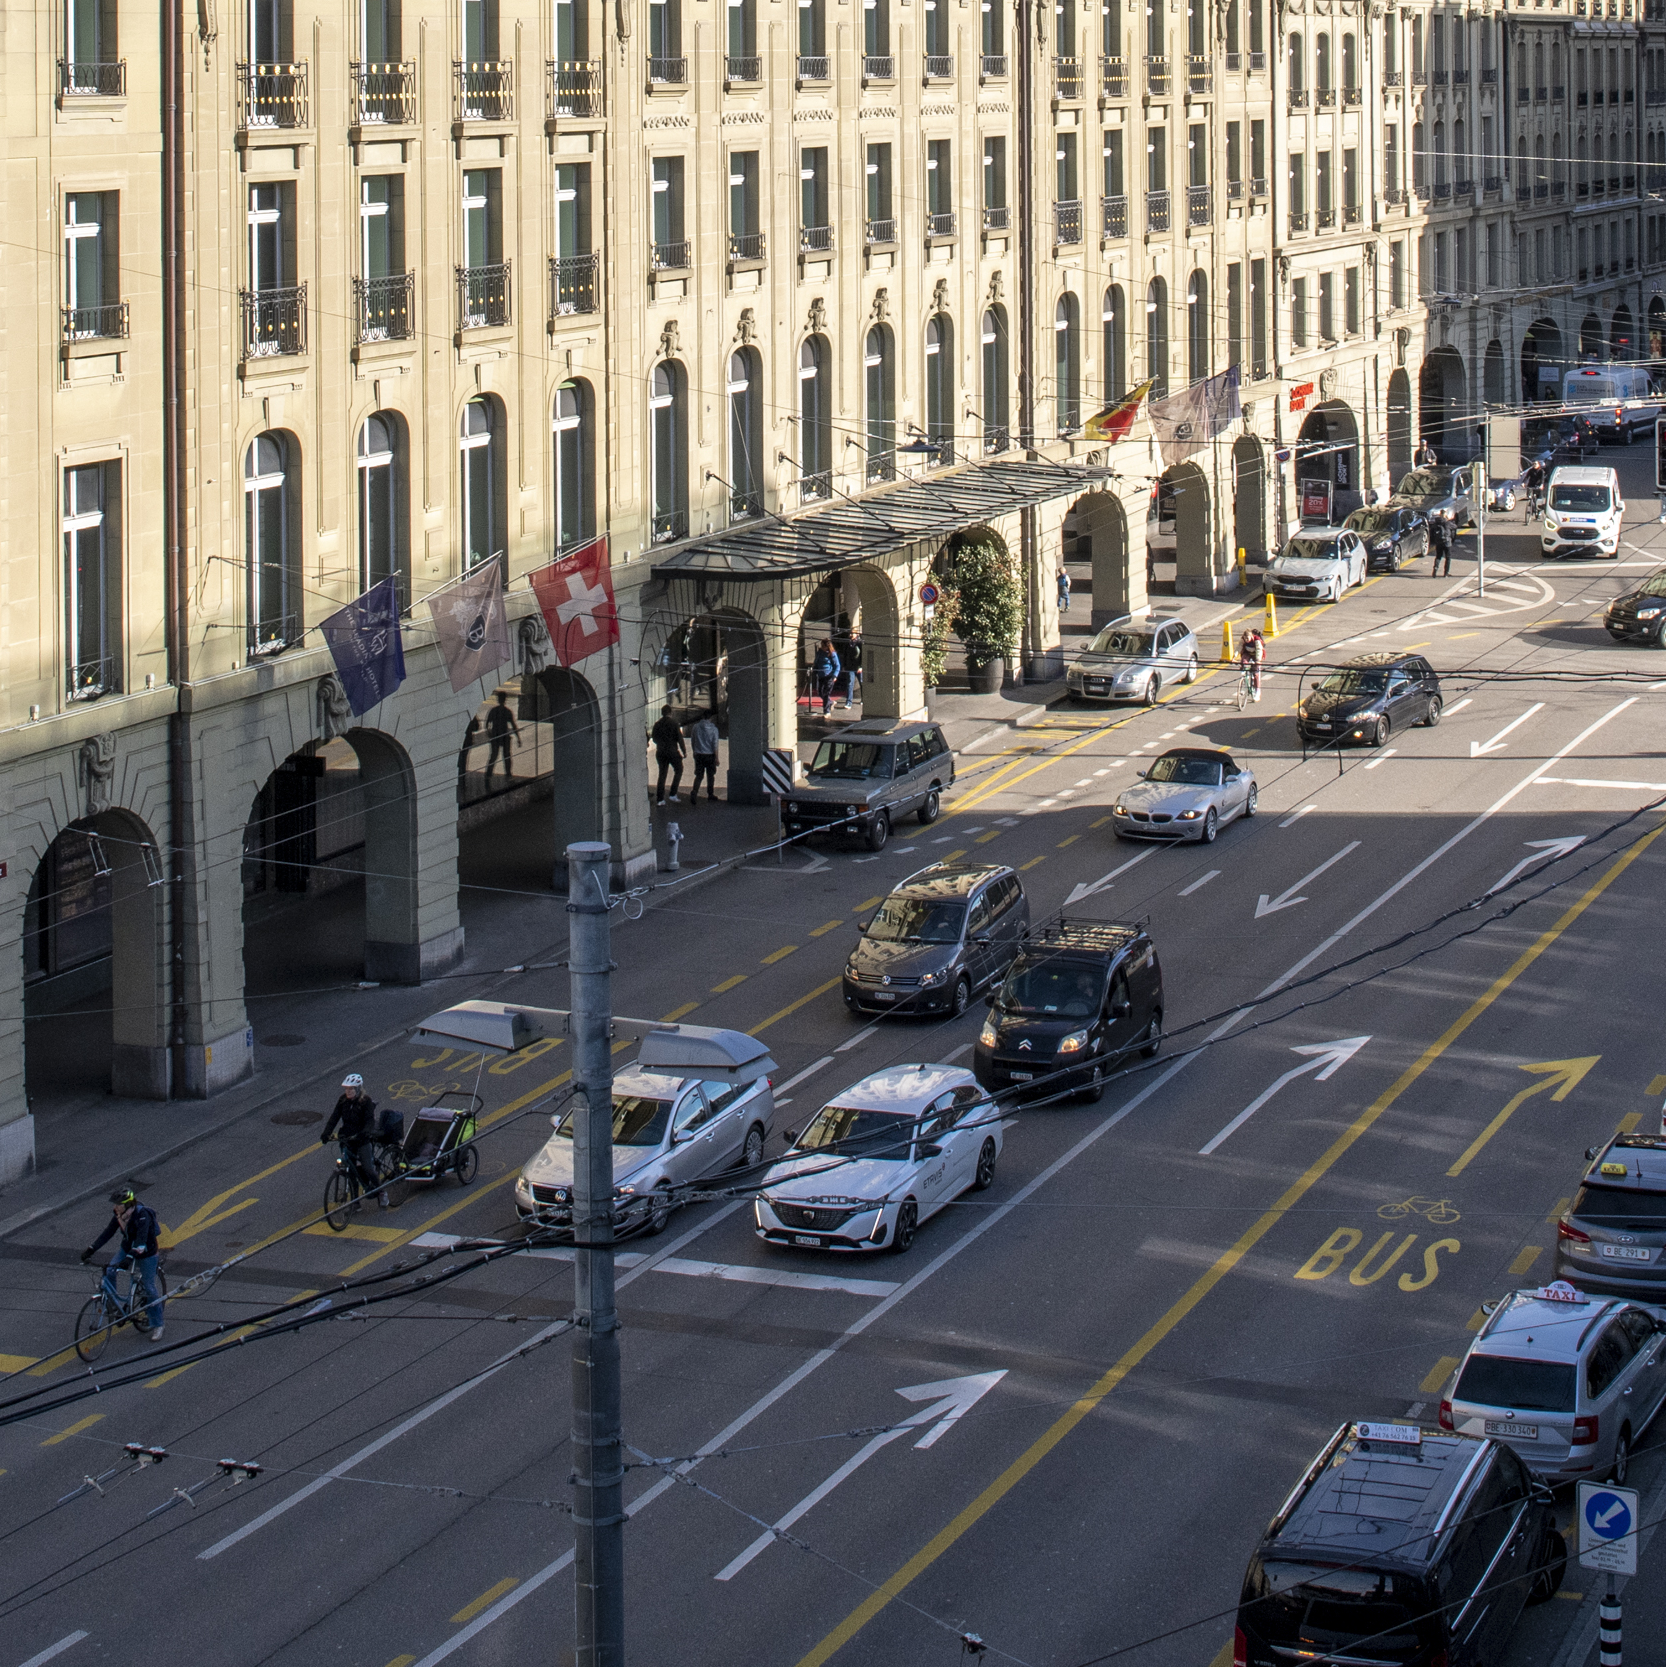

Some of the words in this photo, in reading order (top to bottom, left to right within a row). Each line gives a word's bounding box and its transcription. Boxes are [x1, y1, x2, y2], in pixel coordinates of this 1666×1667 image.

[1613, 1248, 1622, 1256] BE
[1625, 1248, 1638, 1257] 291
[1293, 1227, 1461, 1292] BUS
[1544, 1288, 1576, 1301] TAXI
